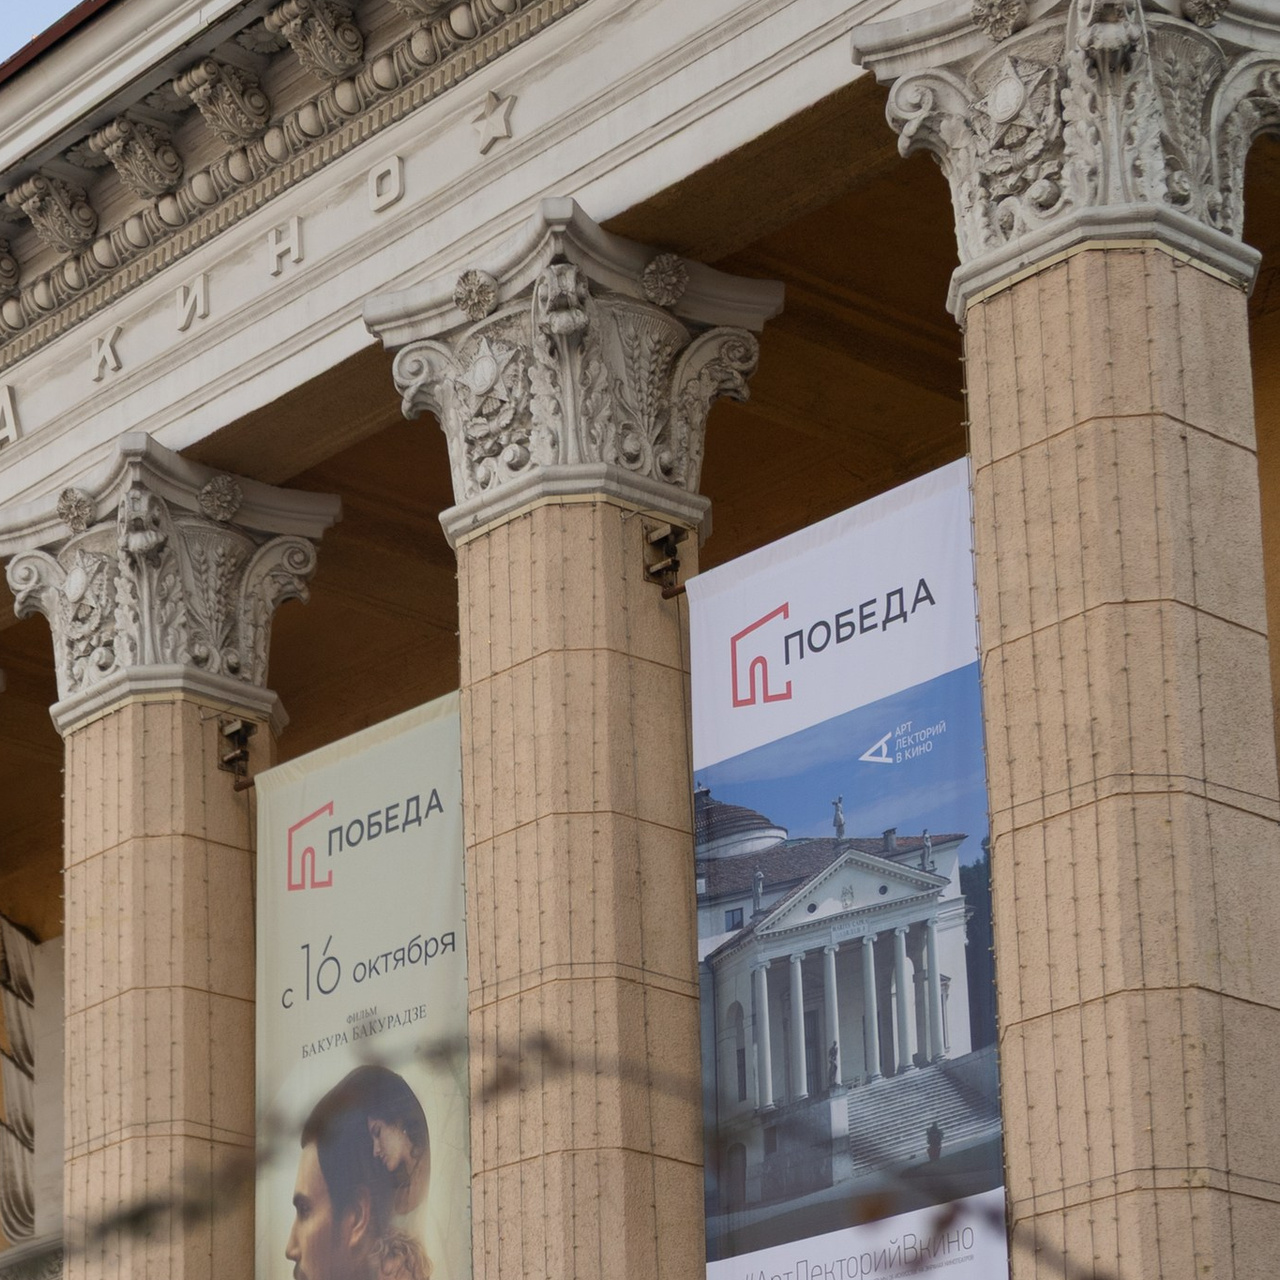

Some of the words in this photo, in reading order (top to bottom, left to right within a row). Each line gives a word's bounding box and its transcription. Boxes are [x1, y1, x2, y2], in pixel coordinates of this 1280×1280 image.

[91, 153, 406, 382] КИНО
[784, 577, 936, 666] ПОБЕДА
[894, 720, 913, 737] АРТ
[894, 720, 946, 751] ЛЕКТОРИЙ
[895, 751, 903, 763] В
[904, 740, 933, 761] КИНО
[327, 788, 444, 856] ПОБЕДА
[281, 986, 293, 1009] с
[300, 935, 341, 1001] 16
[352, 931, 456, 984] октября
[301, 1030, 349, 1059] БАКУРА
[351, 1003, 428, 1041] БАКУРАДЗЕ
[346, 1005, 378, 1025] ФИЛЬМ
